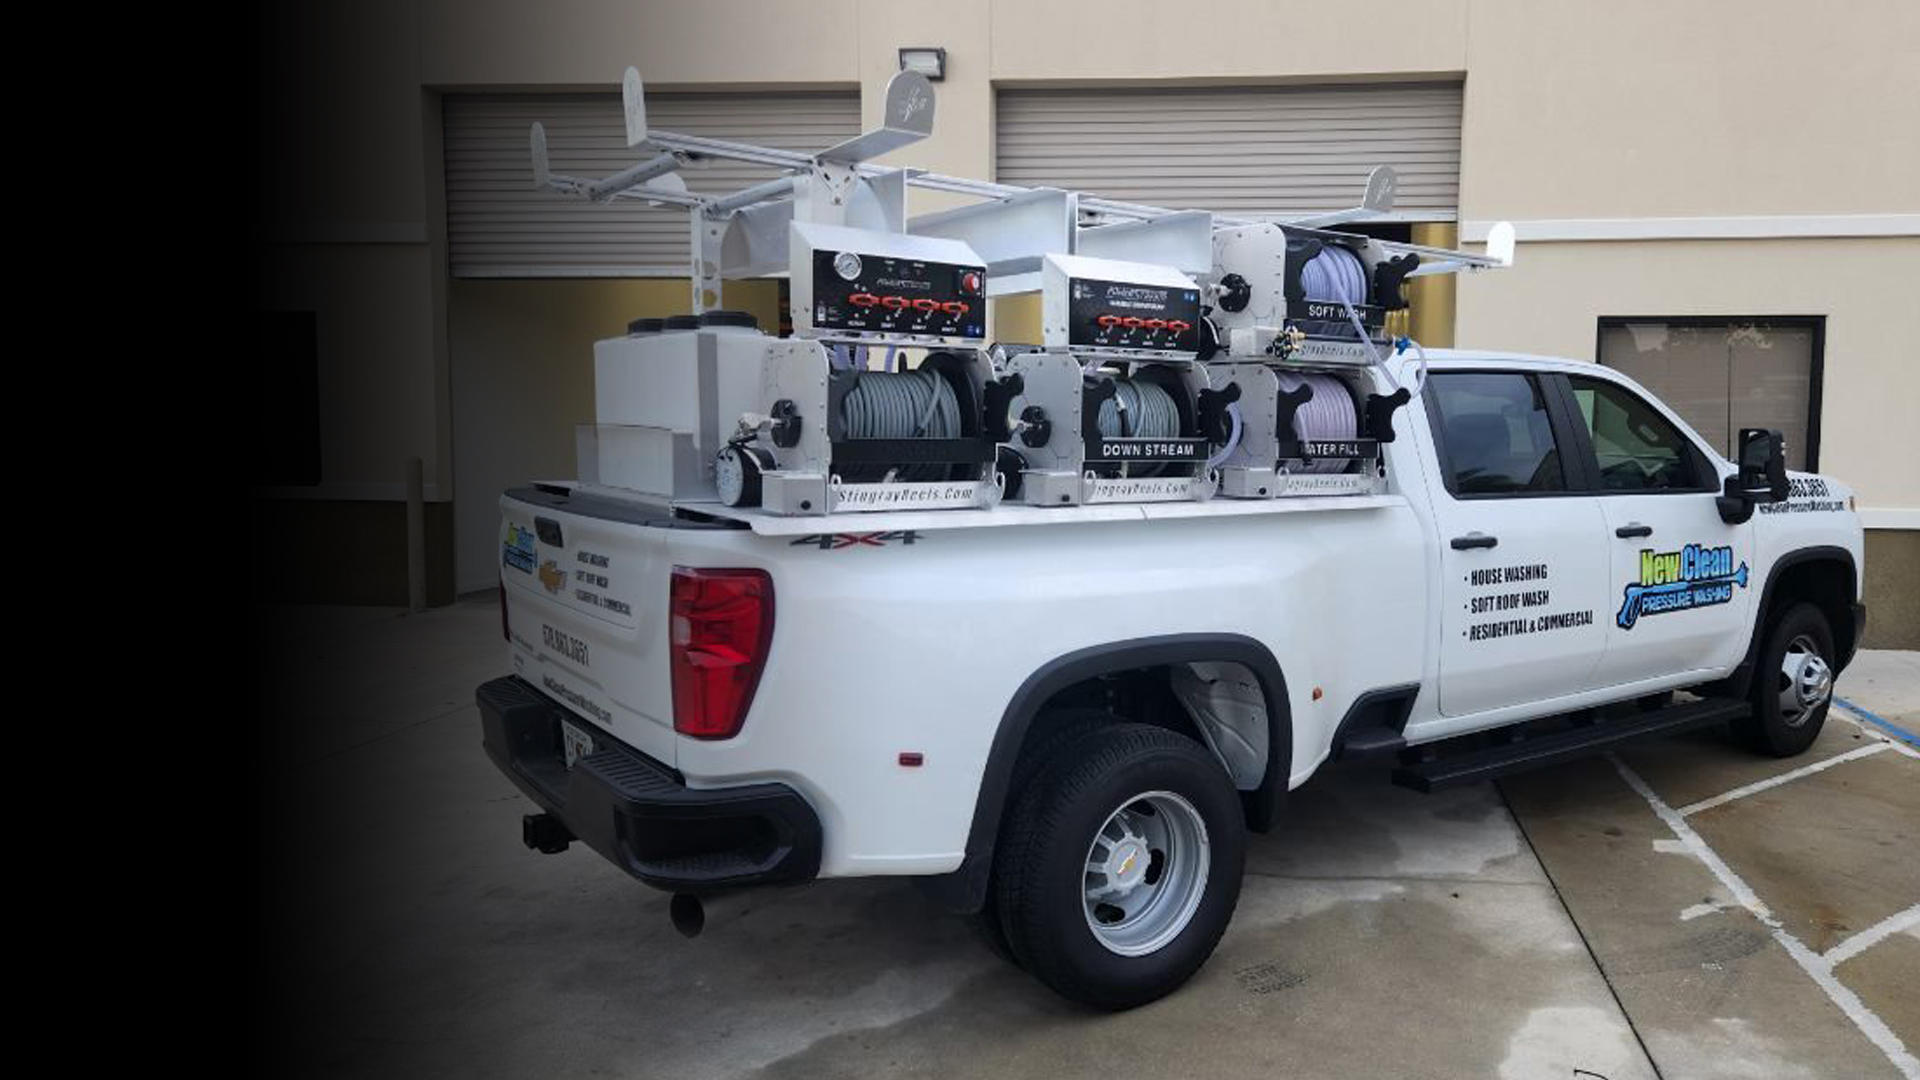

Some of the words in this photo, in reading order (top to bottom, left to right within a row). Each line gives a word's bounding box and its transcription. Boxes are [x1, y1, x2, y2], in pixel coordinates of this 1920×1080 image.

[1308, 304, 1335, 318] SOFT
[1102, 443, 1141, 457] DOWN
[1144, 443, 1195, 456] STREAM
[1304, 443, 1337, 456] ATER
[1338, 443, 1360, 456] FILL
[838, 487, 974, 505] StingrayReels.Com
[1470, 566, 1503, 587] HOUSE
[1503, 563, 1548, 583] WASHING
[1640, 548, 1682, 588] New
[1682, 543, 1733, 582] Clean
[1470, 595, 1495, 614] SOFT
[1496, 593, 1521, 611] ROOF
[1521, 589, 1549, 608] WASH
[1641, 590, 1692, 613] PRESSURE
[1693, 582, 1732, 602] WASHING
[1469, 618, 1527, 642] RESIDENTIAL
[1528, 619, 1537, 634] &
[1537, 609, 1593, 632] COMMERCIAL
